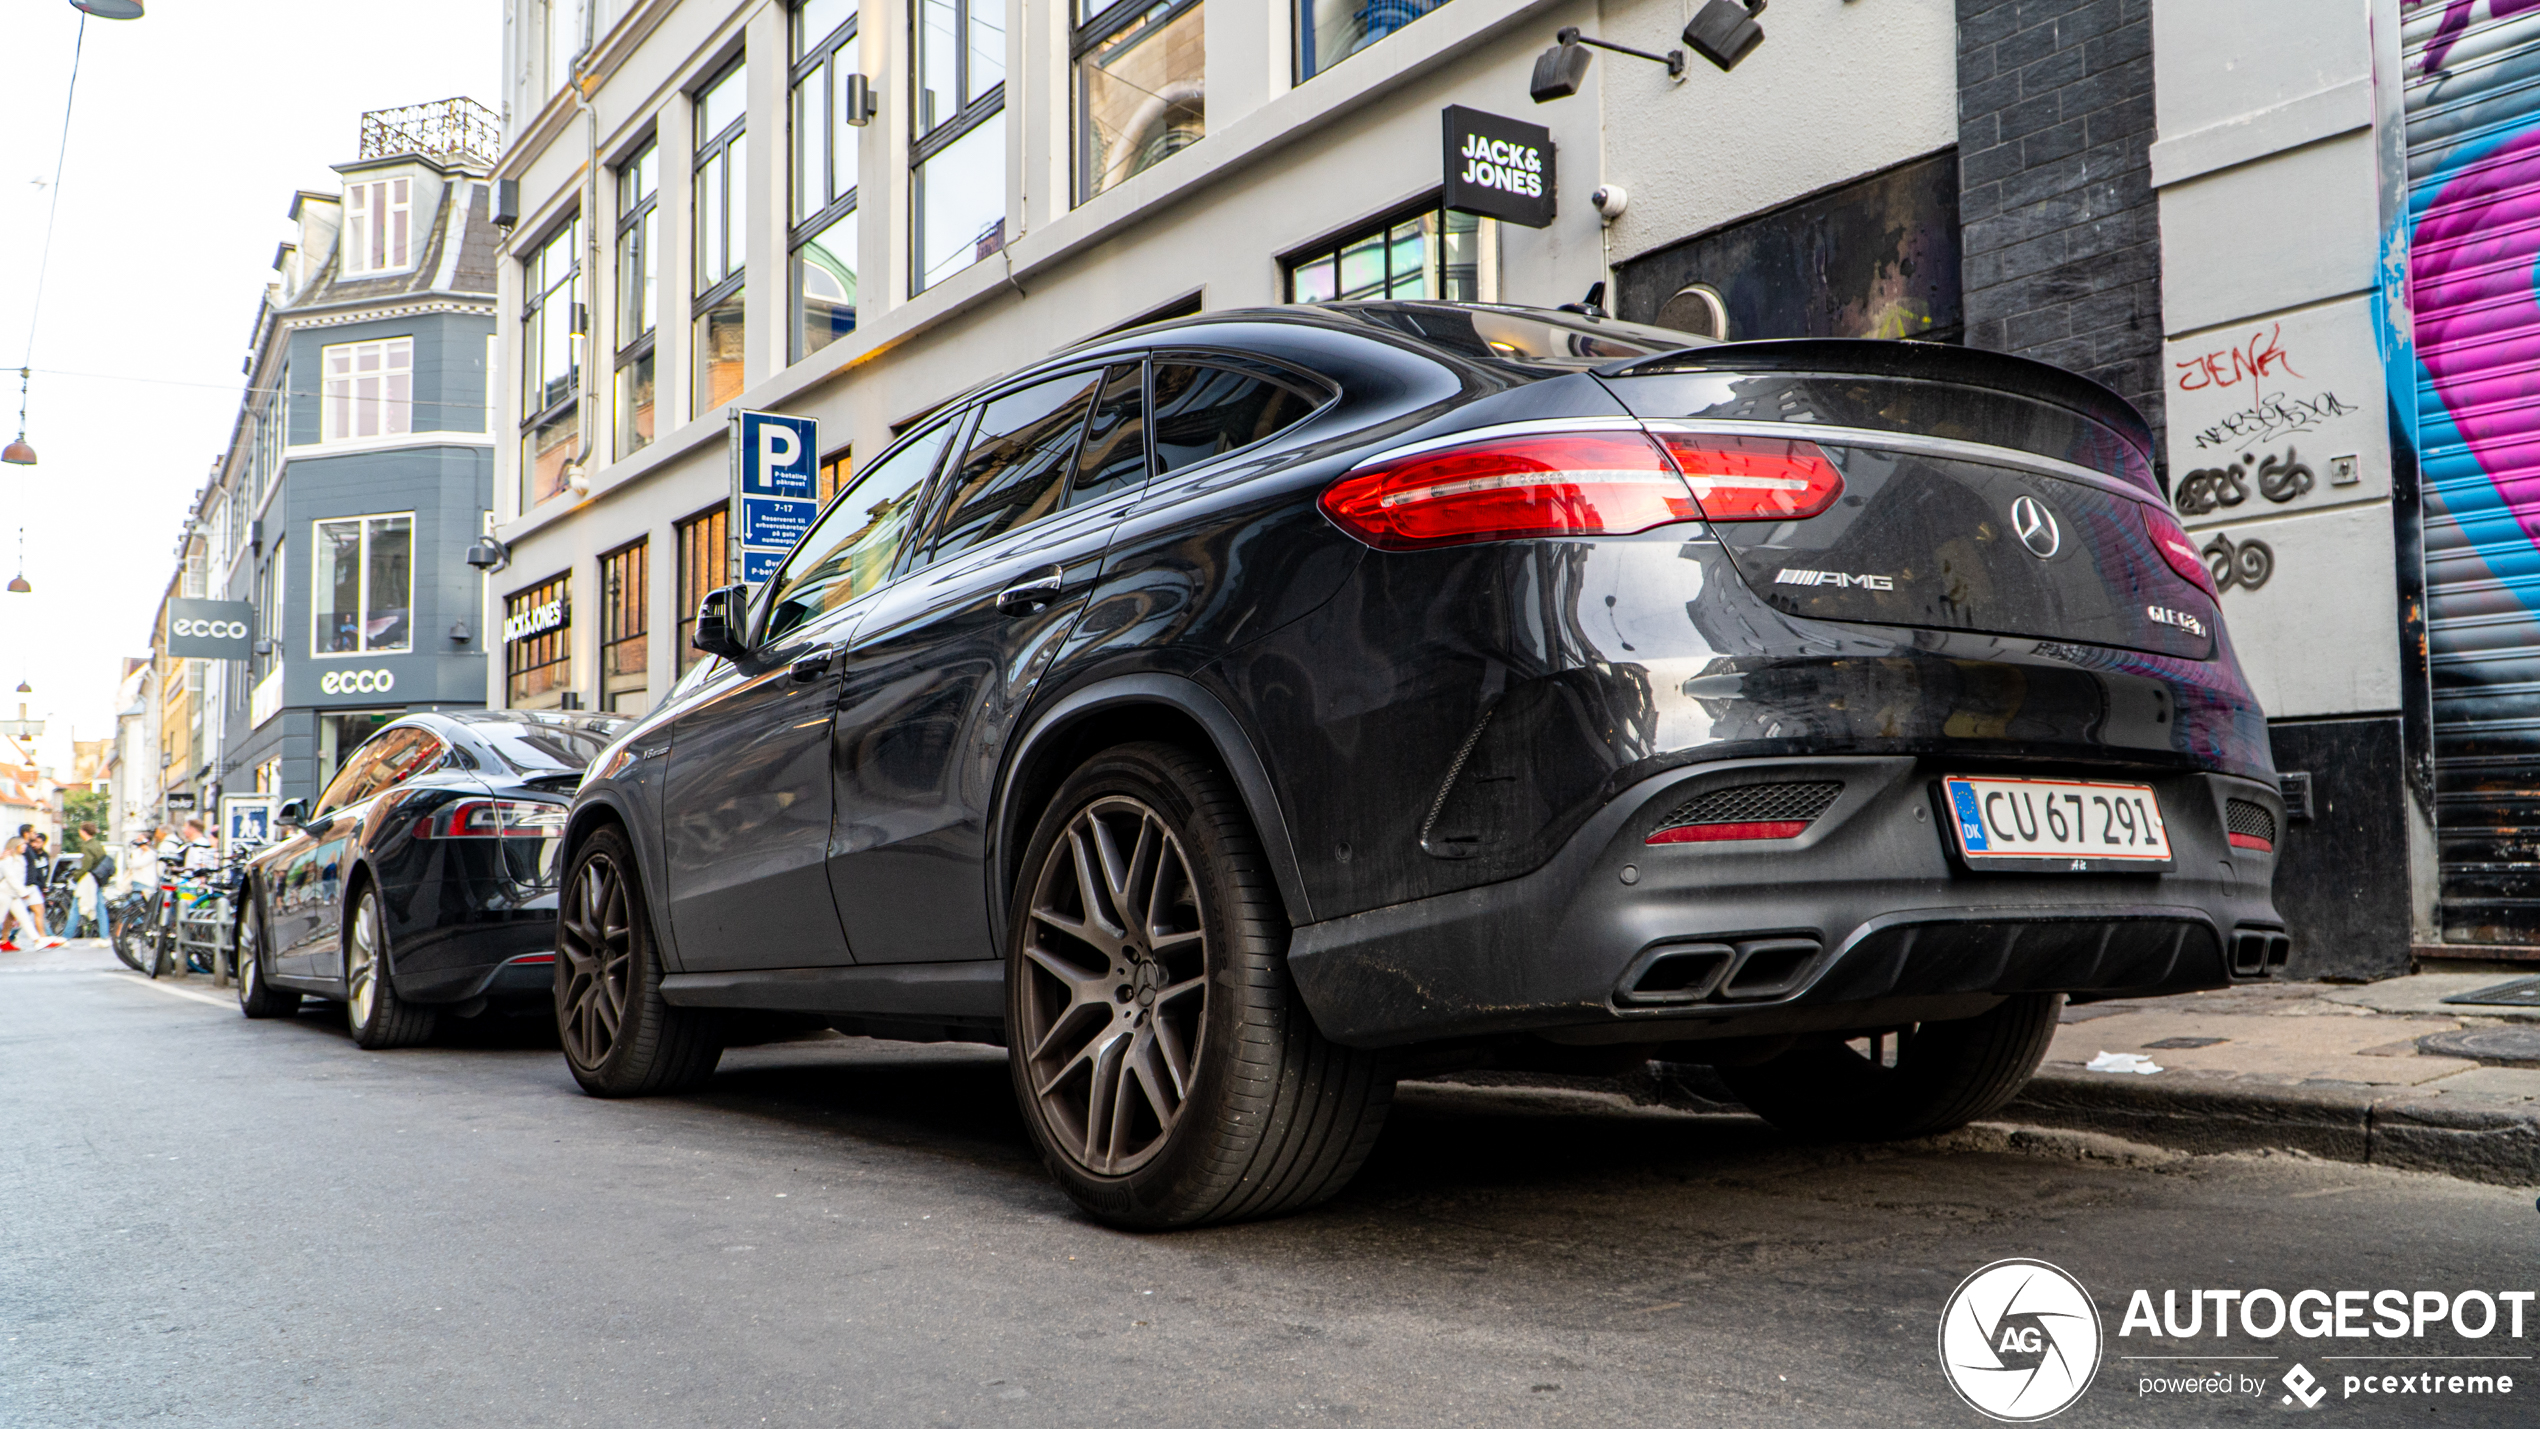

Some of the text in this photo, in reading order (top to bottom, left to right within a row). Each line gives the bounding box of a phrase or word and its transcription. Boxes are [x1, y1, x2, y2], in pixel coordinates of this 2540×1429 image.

[1461, 133, 1542, 173] JACK&
[1462, 159, 1542, 198] JONES
[759, 422, 801, 487] P
[774, 471, 807, 482] P-betaling
[776, 479, 806, 487] påkrævet
[774, 503, 793, 513] 7-17
[761, 514, 796, 524] Reserveret
[1813, 571, 1893, 591] AMG
[172, 618, 247, 639] ecco
[321, 669, 394, 695] ecco
[1985, 791, 2158, 846] CU 67 291
[1963, 823, 1981, 839] DK
